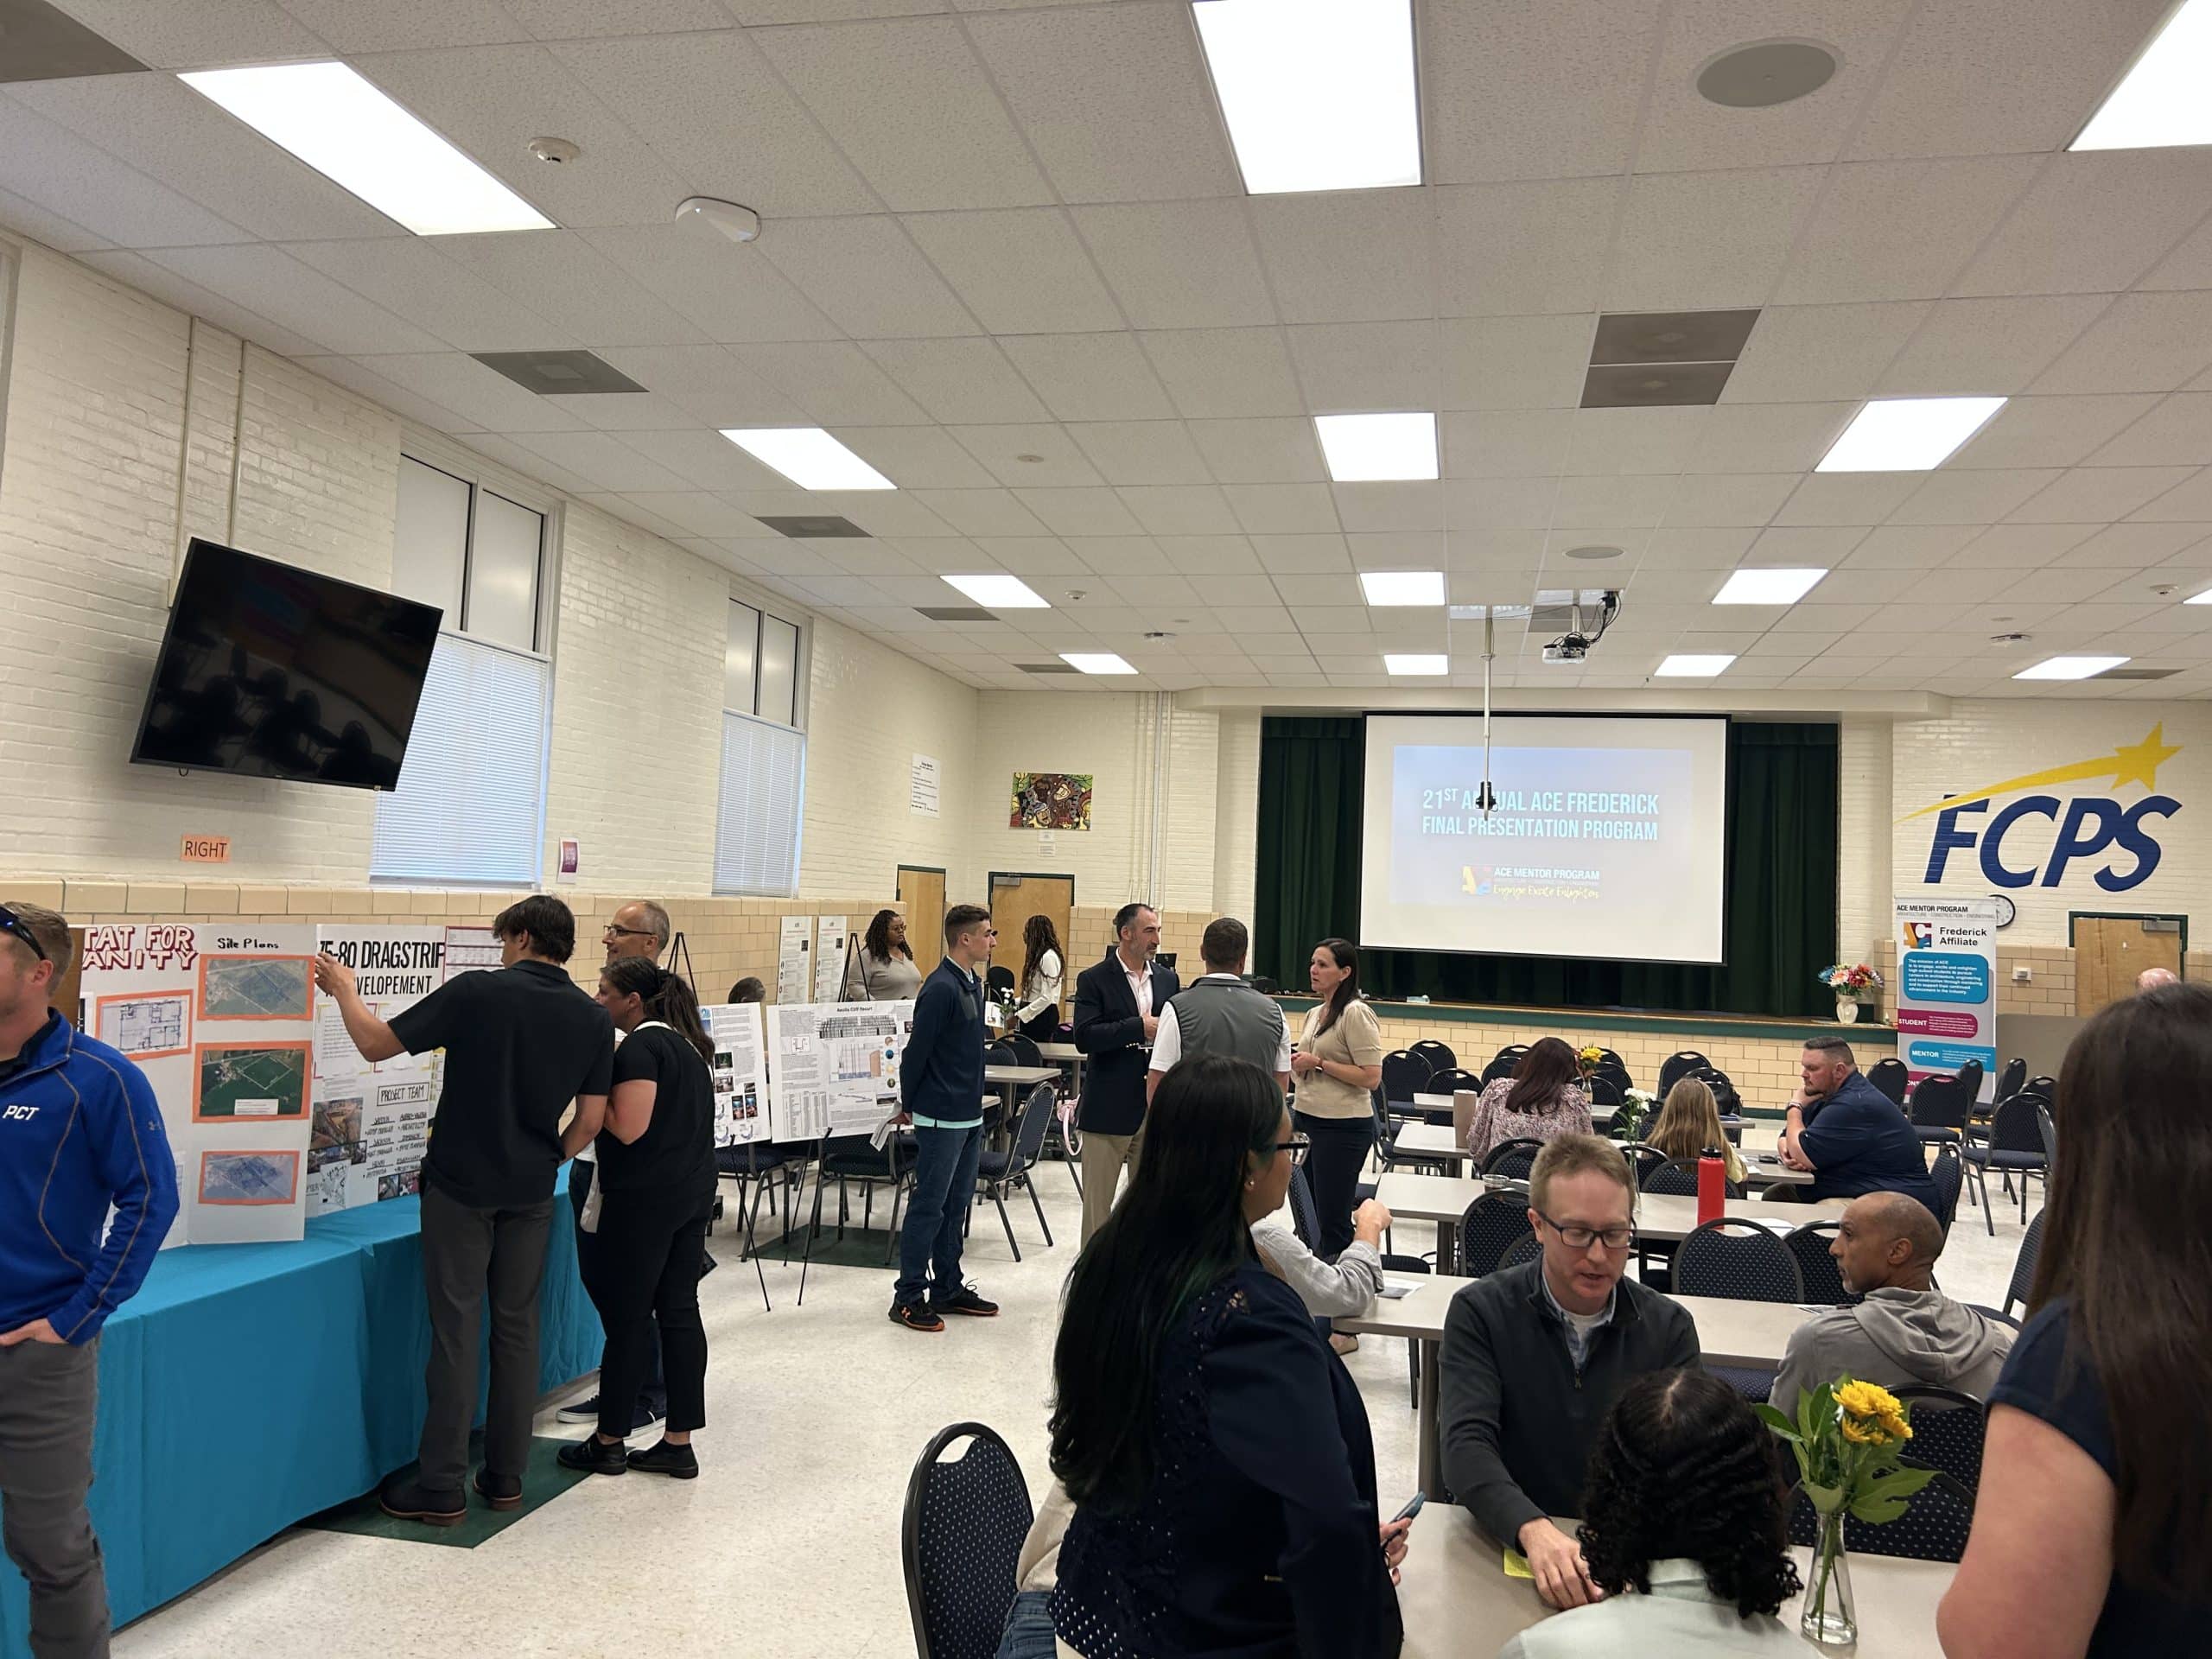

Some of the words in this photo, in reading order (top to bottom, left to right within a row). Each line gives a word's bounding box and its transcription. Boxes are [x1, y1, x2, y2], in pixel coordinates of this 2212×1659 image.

[1530, 792, 1563, 812] ACE
[1567, 792, 1660, 815] FREDERICK
[1422, 816, 1465, 835] FINAL
[1468, 817, 1580, 838] PRESENTATION
[1583, 820, 1658, 840] PROGRAM
[184, 841, 227, 858] RIGHT
[1923, 794, 2183, 893] FCPS
[1494, 868, 1513, 877] ACE
[1514, 868, 1552, 878] MENTOR
[1554, 869, 1600, 880] PROGRAM
[144, 925, 195, 951] FOR
[1940, 927, 1987, 937] Frederick
[243, 938, 279, 949] Plans
[1940, 937, 1978, 946] Affiliate
[380, 1087, 405, 1103] PROJECT
[408, 1084, 424, 1100] TEAM
[3, 1105, 41, 1121] PCT
